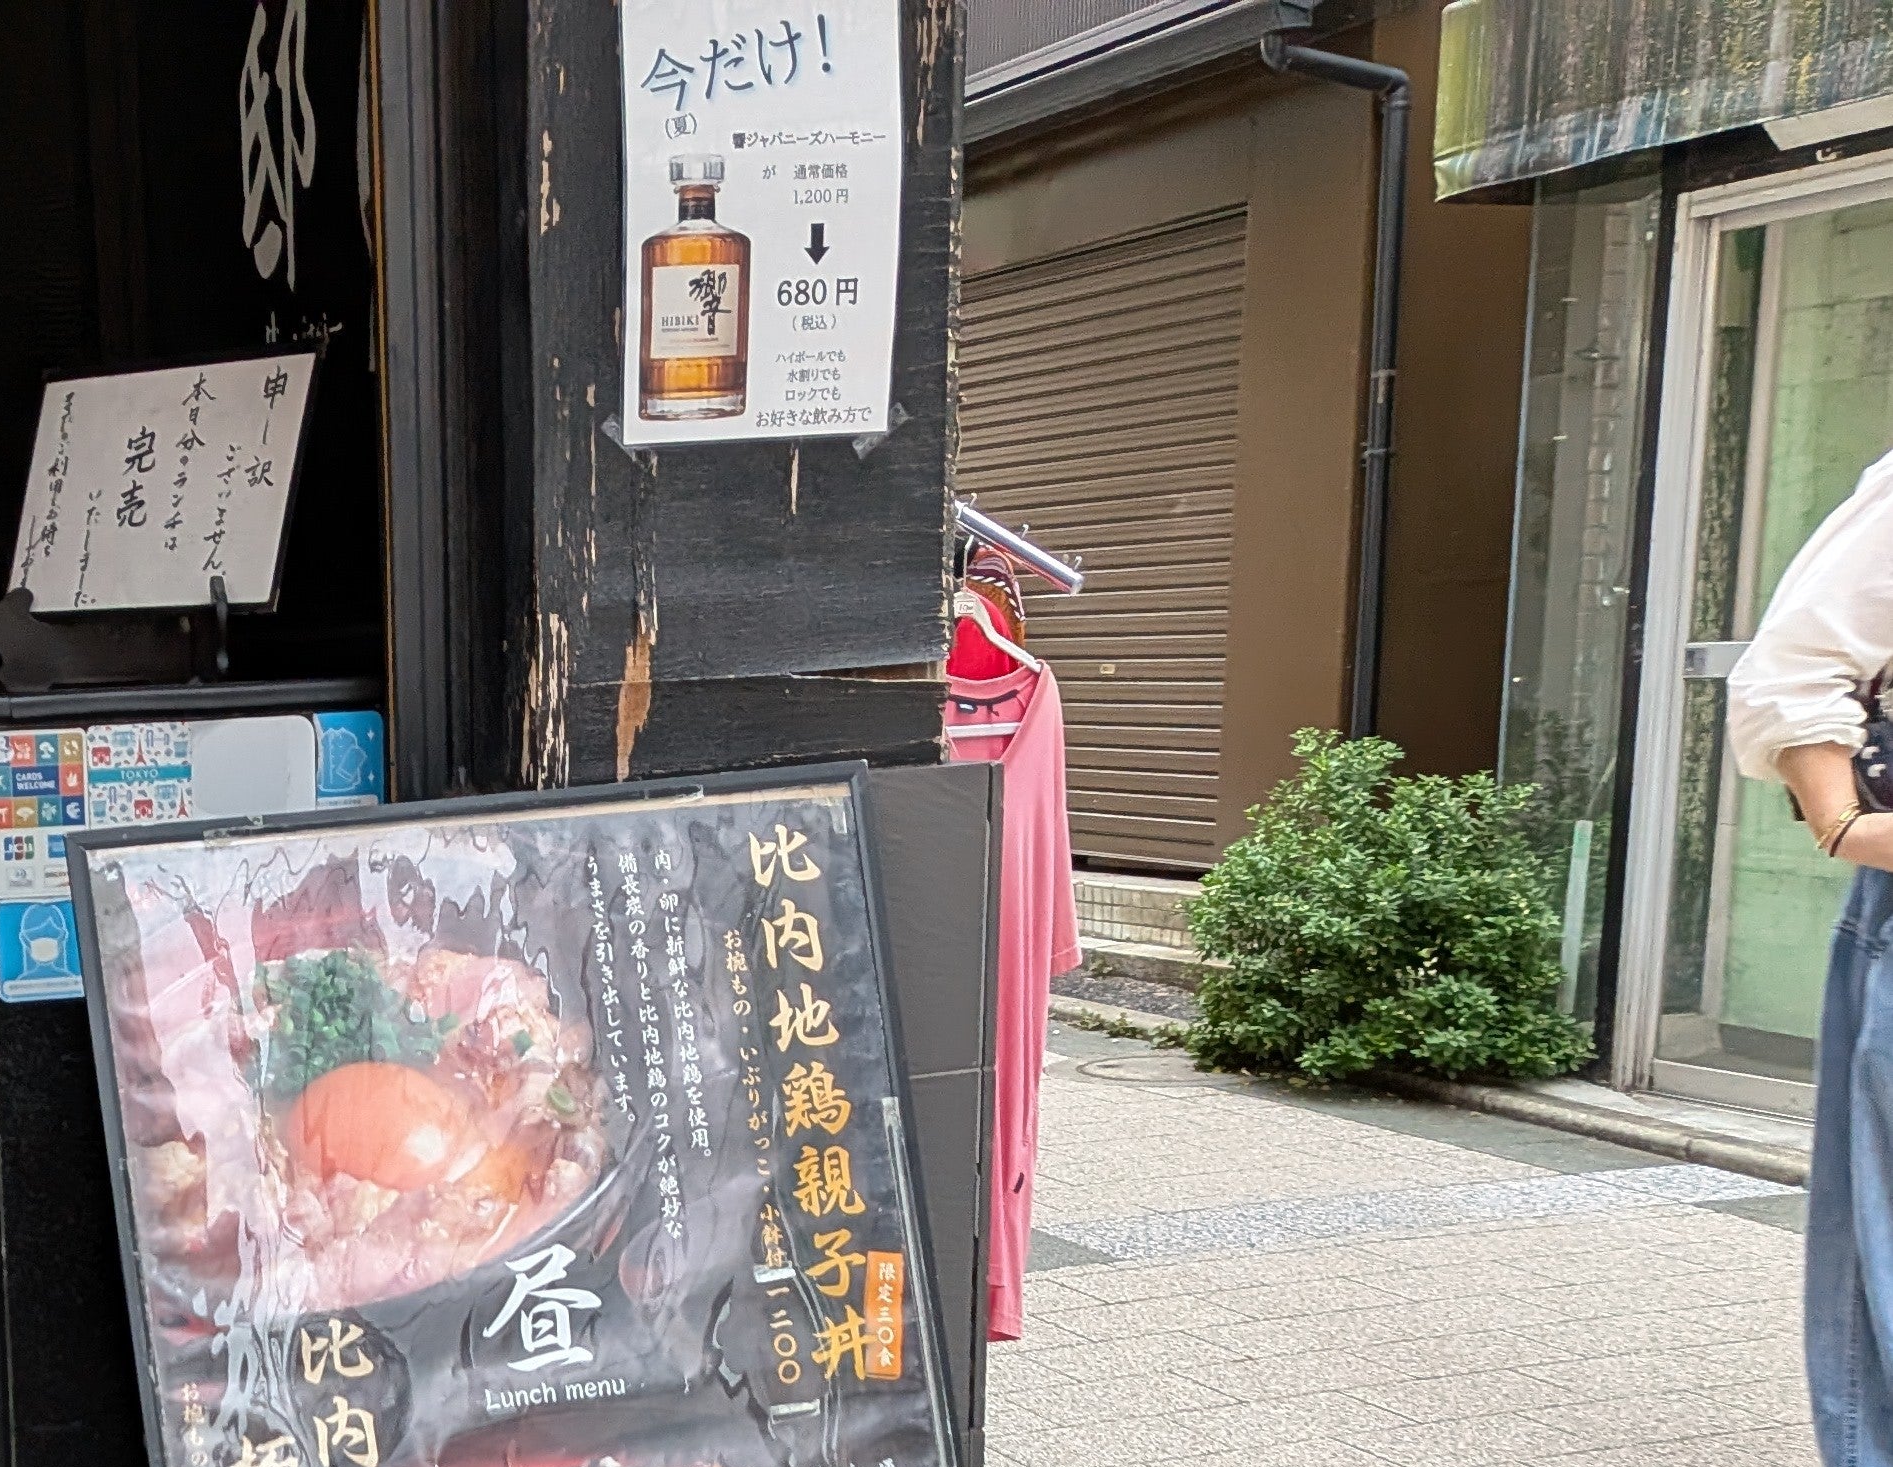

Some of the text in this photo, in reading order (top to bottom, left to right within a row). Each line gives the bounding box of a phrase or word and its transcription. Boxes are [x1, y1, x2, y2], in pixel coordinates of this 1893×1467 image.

[640, 13, 831, 111] 今だけ!
[762, 163, 848, 180] が 通常価格
[661, 314, 699, 327] HIBIKI
[792, 313, 837, 331] (税込)
[775, 350, 846, 364] ハイボールでも
[787, 367, 841, 383] 水割りでも
[785, 386, 841, 401] ロックでも
[243, 365, 289, 487] 申し訳
[756, 406, 872, 428] お好きな飲み方で
[116, 426, 156, 528] 完売
[15, 771, 43, 782] CARDS
[120, 769, 159, 781] TOKYO
[16, 780, 56, 791] WELCOME
[585, 855, 636, 1124] うまさを引き出しています。
[749, 824, 877, 1381] 比内地鶏親子丼
[482, 1243, 603, 1372] 昼
[484, 1377, 626, 1411] Lunch menu
